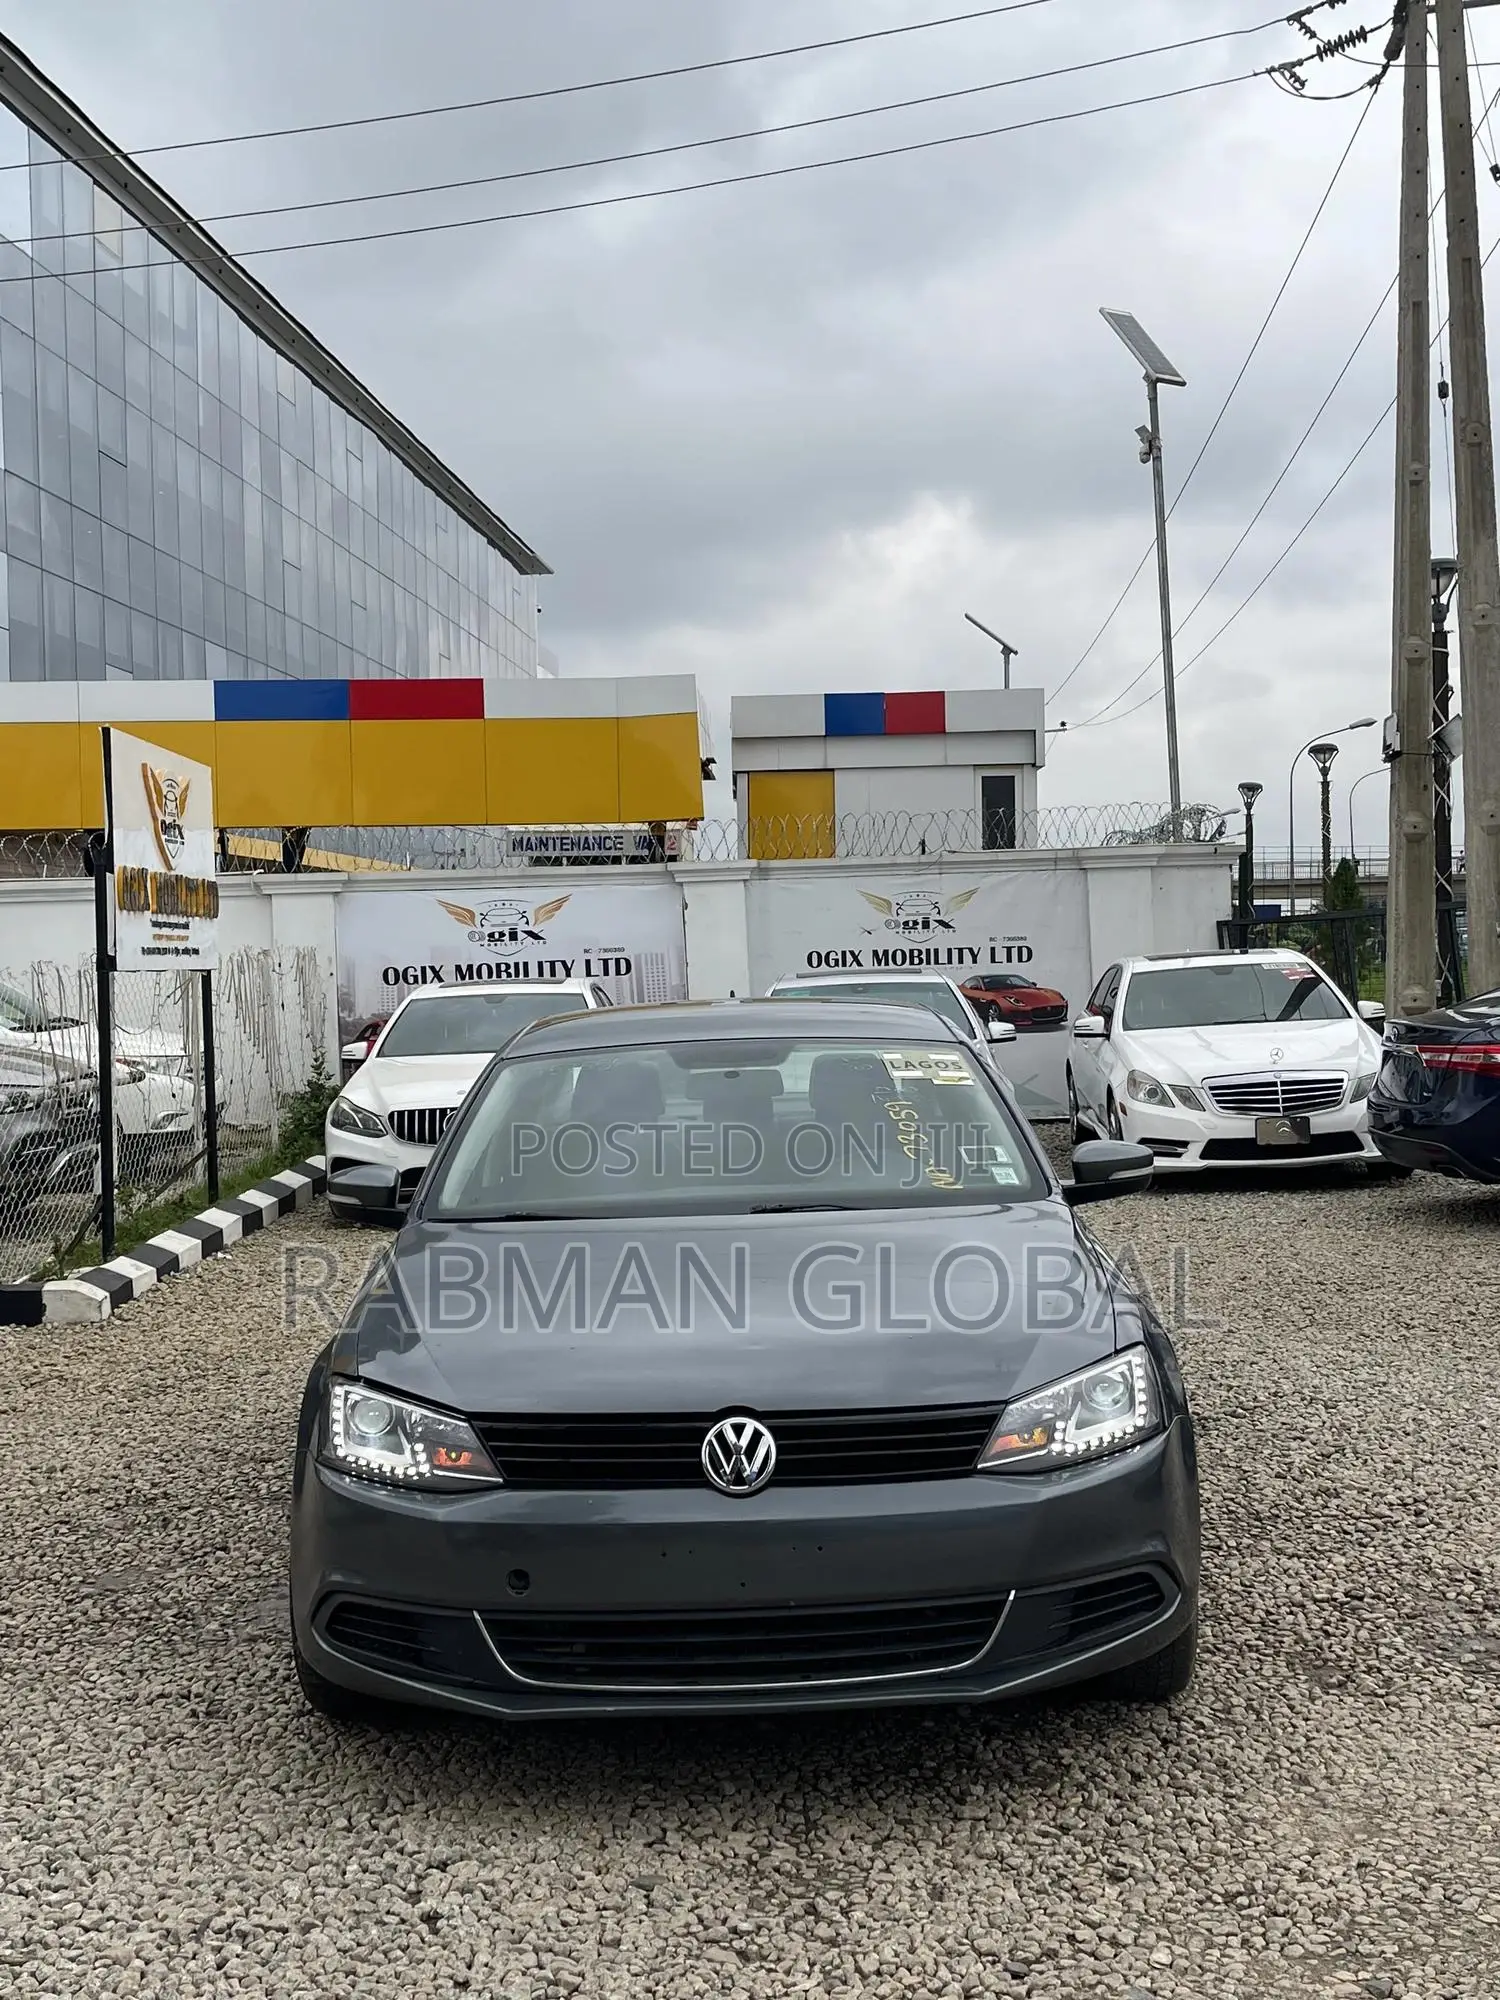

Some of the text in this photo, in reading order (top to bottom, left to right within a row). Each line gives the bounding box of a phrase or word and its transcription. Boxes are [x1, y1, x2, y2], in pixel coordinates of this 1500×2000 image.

[511, 835, 624, 852] MAINTENANCE
[806, 945, 1034, 969] OGIX MOBILITY LTD
[382, 957, 633, 986] OGIX MOBILITY LTD
[888, 1060, 964, 1071] LAGOS
